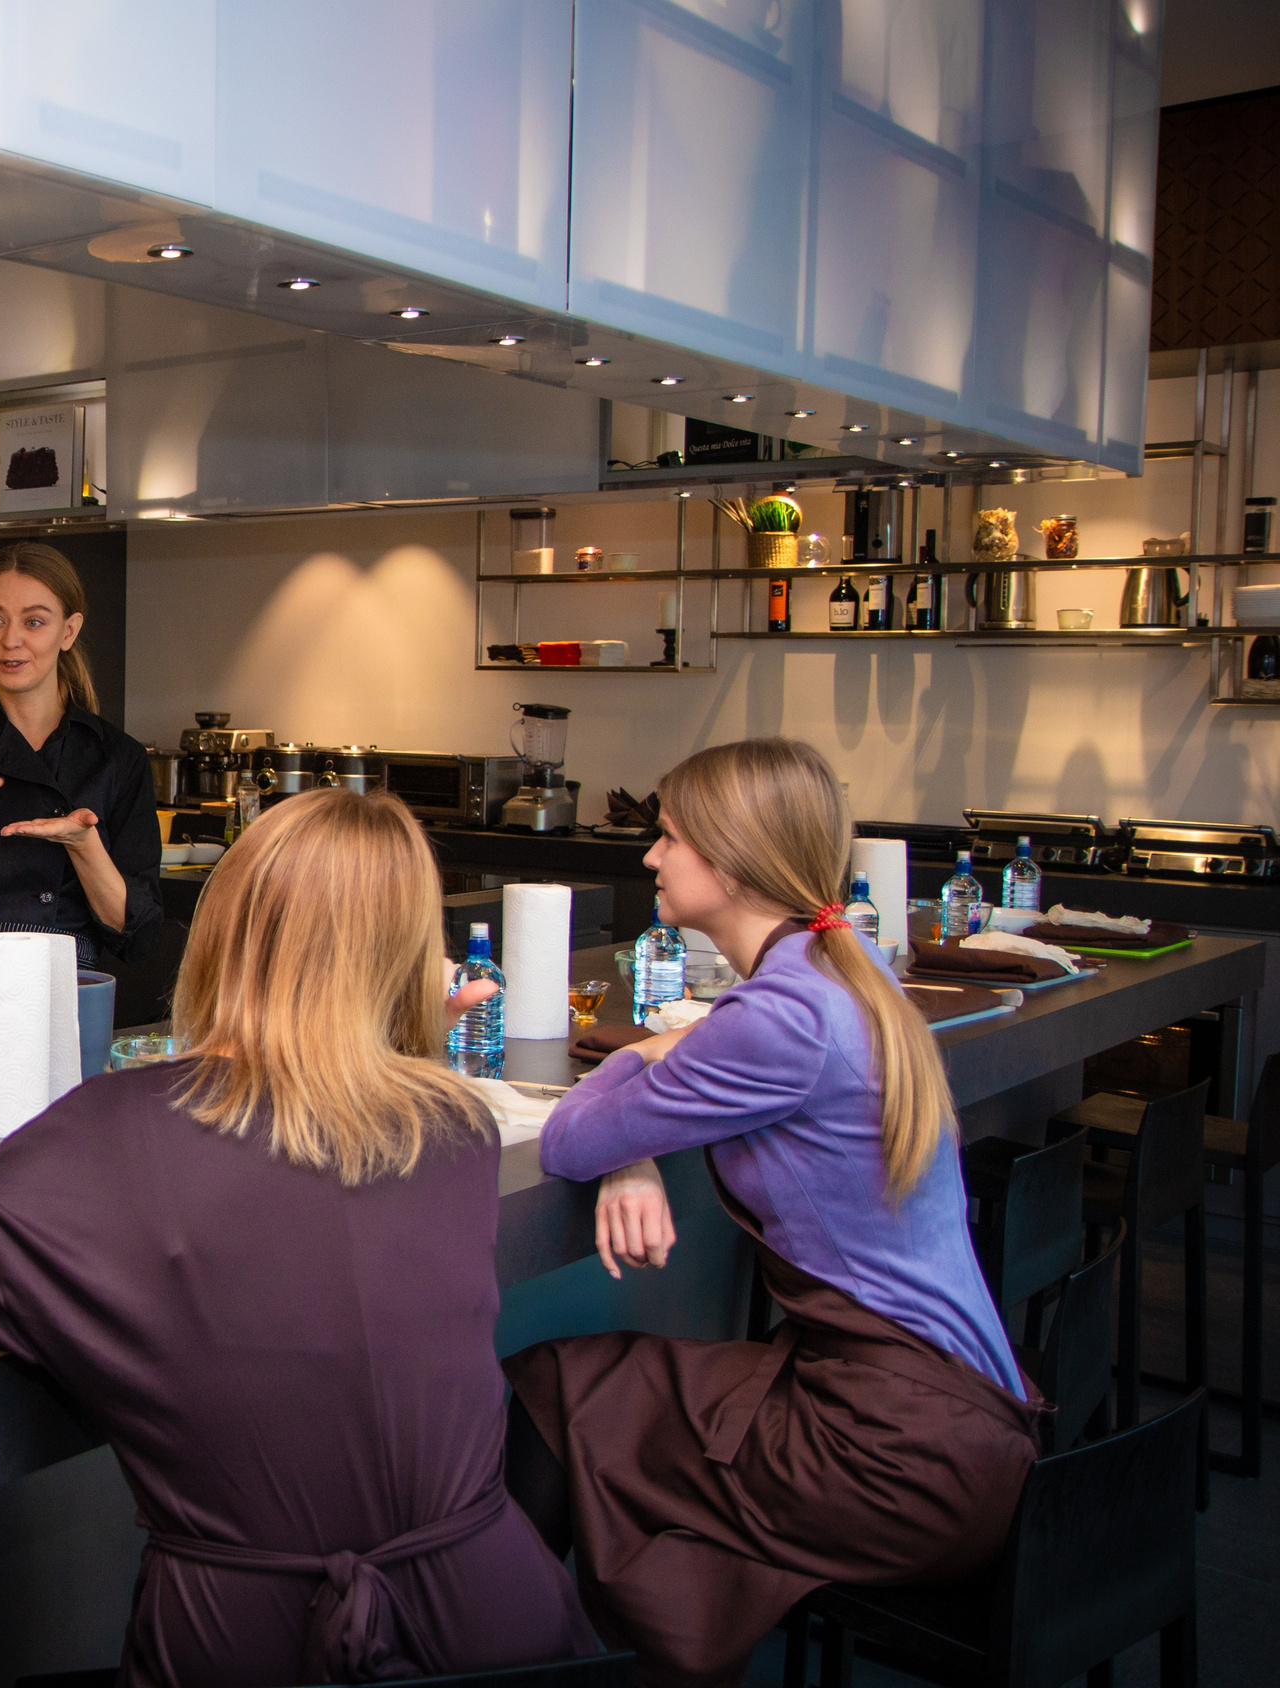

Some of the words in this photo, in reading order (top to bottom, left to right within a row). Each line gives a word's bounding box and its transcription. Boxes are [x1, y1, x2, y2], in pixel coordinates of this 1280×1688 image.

[5, 417, 30, 428] STYLE
[31, 418, 37, 426] &
[39, 413, 65, 425] TASTE
[722, 438, 739, 449] Dolce
